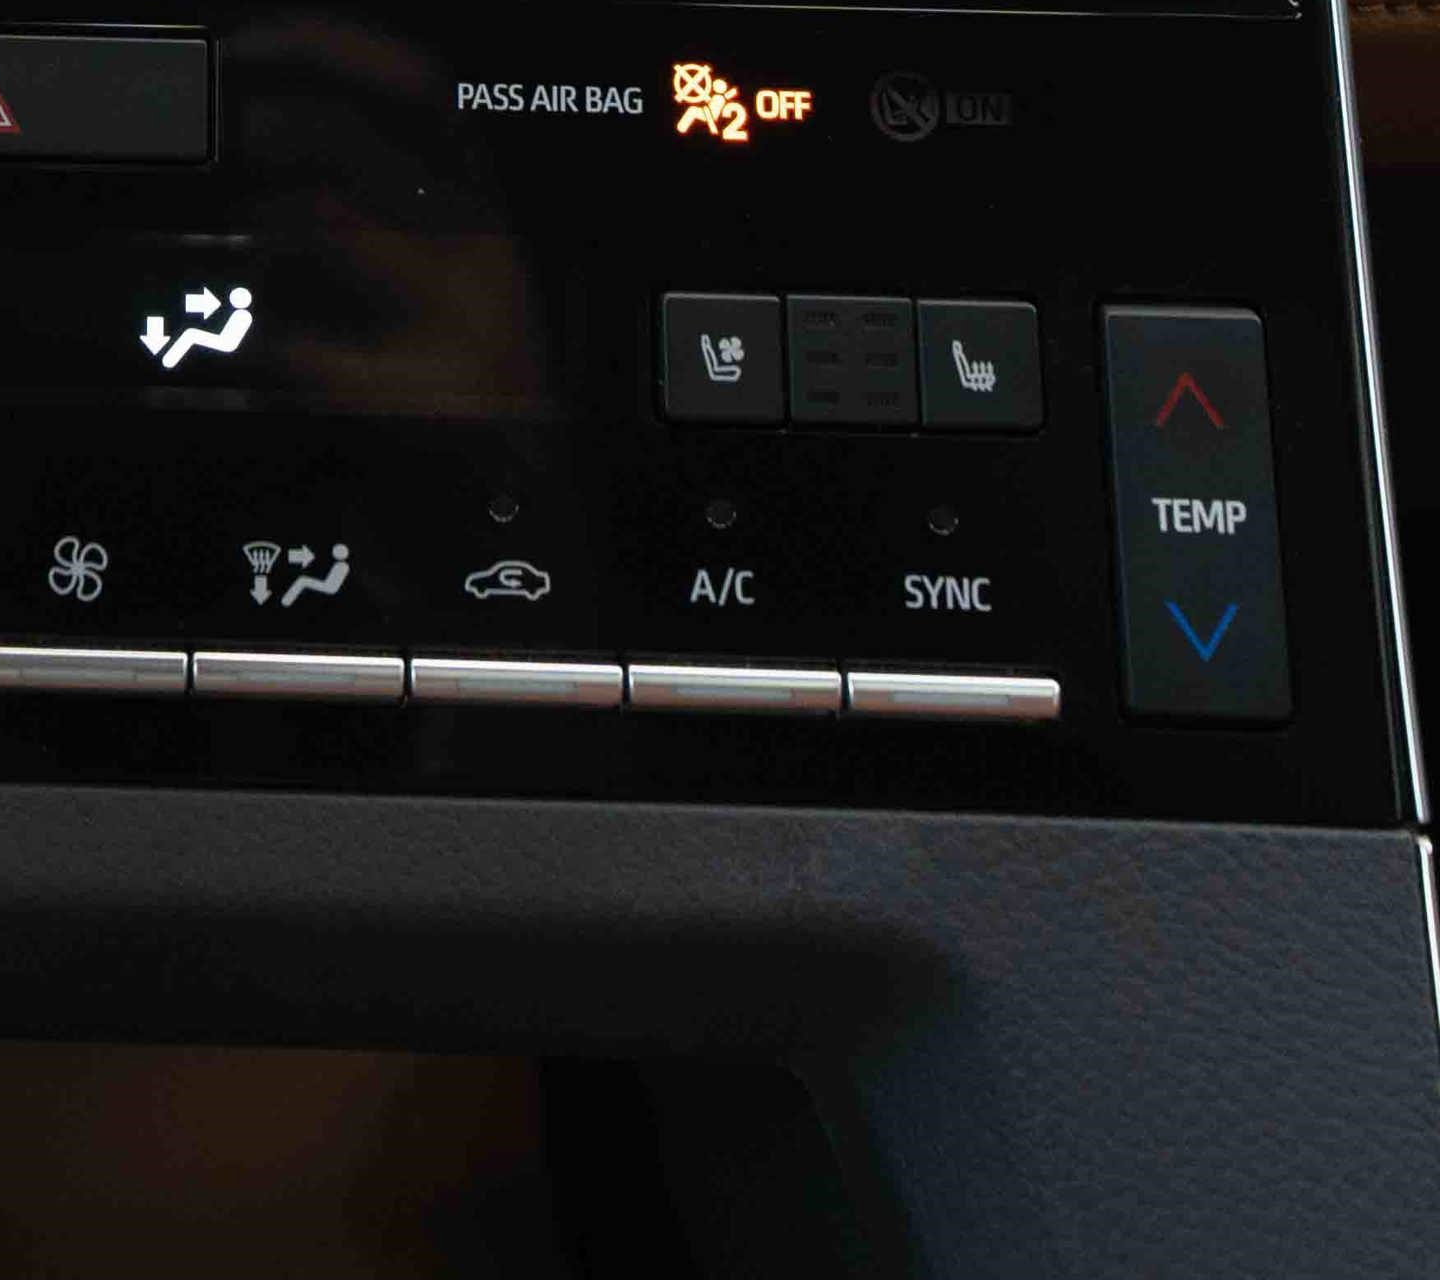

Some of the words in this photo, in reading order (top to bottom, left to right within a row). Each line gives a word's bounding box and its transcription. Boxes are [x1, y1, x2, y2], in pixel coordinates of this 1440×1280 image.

[457, 83, 524, 111] PASS
[530, 85, 577, 113] AIR
[585, 86, 643, 114] BAG
[756, 90, 812, 120] OFF
[1152, 498, 1247, 534] TEMP
[691, 570, 755, 605] A/C
[904, 575, 991, 611] SYNC
